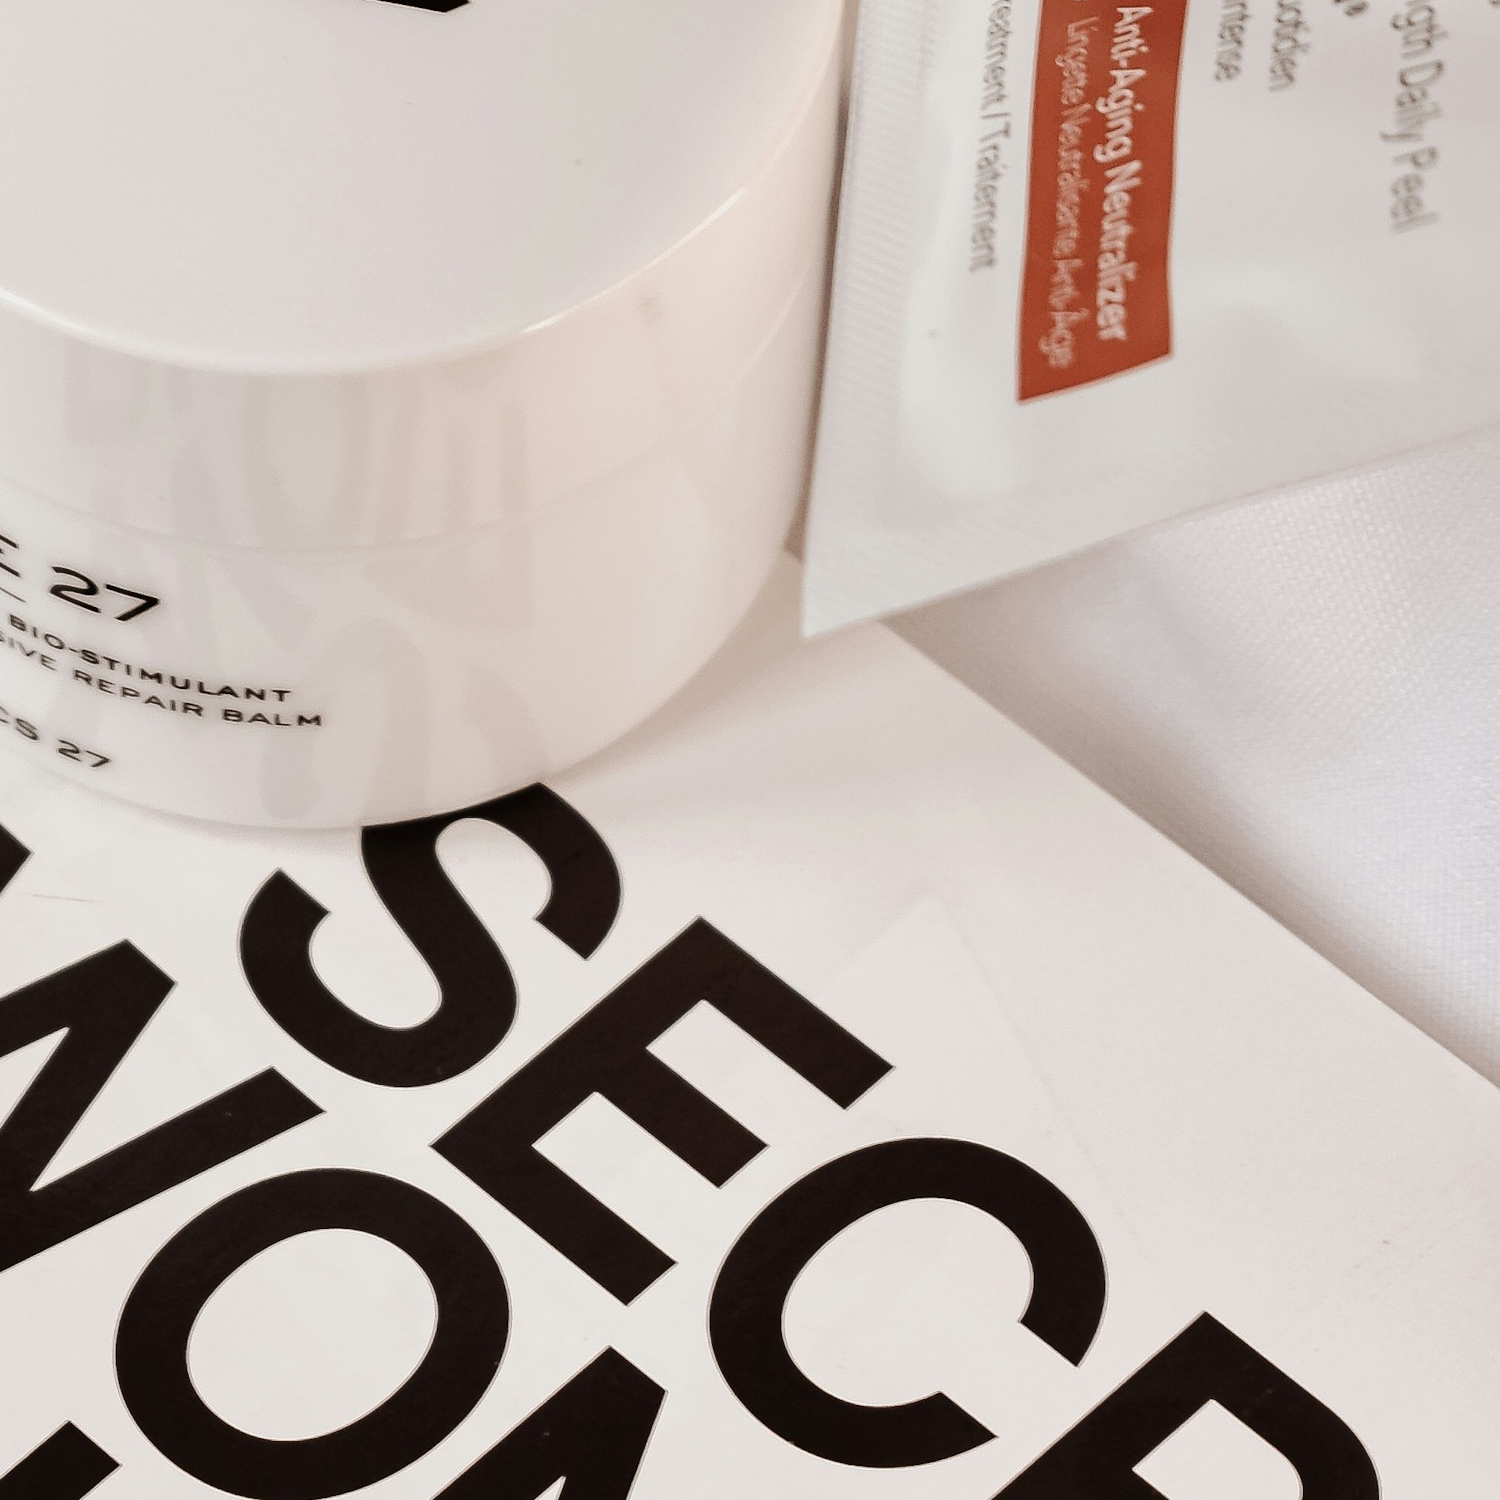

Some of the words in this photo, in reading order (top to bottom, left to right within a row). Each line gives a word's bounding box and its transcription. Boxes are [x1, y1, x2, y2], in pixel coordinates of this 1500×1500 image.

[1093, 5, 1154, 163] Anti-Aging
[1380, 60, 1445, 144] Daily
[969, 122, 1013, 274] Traitement
[1390, 145, 1441, 235] Peel
[1096, 159, 1142, 342] Neutralizer
[50, 566, 161, 621] 27
[10, 612, 293, 702] BIO-STIMULANT
[73, 668, 204, 717] REPAIR
[221, 708, 323, 728] BALM
[57, 739, 112, 768] 27
